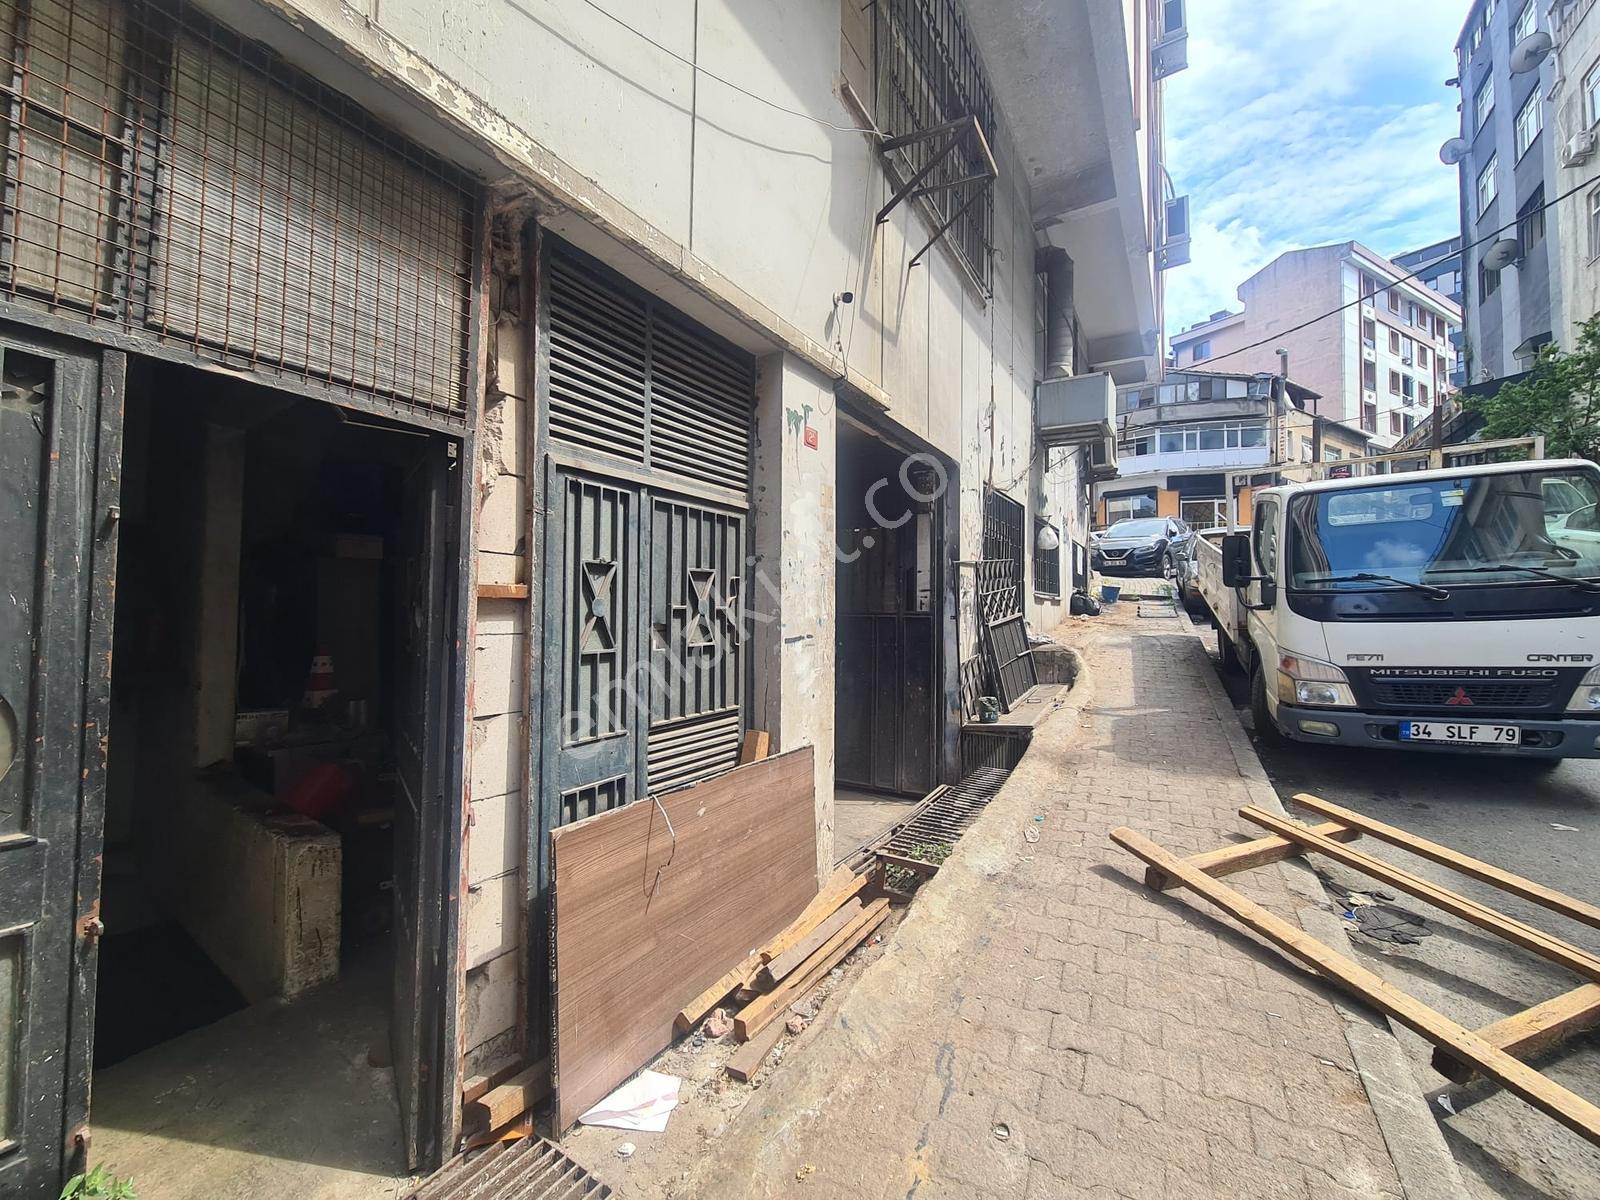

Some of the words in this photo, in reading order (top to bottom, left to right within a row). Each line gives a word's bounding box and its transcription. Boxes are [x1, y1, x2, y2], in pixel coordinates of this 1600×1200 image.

[1526, 654, 1594, 662] CANTER
[1411, 724, 1432, 738] 34
[1446, 725, 1479, 740] SLF
[1493, 727, 1516, 741] 79
